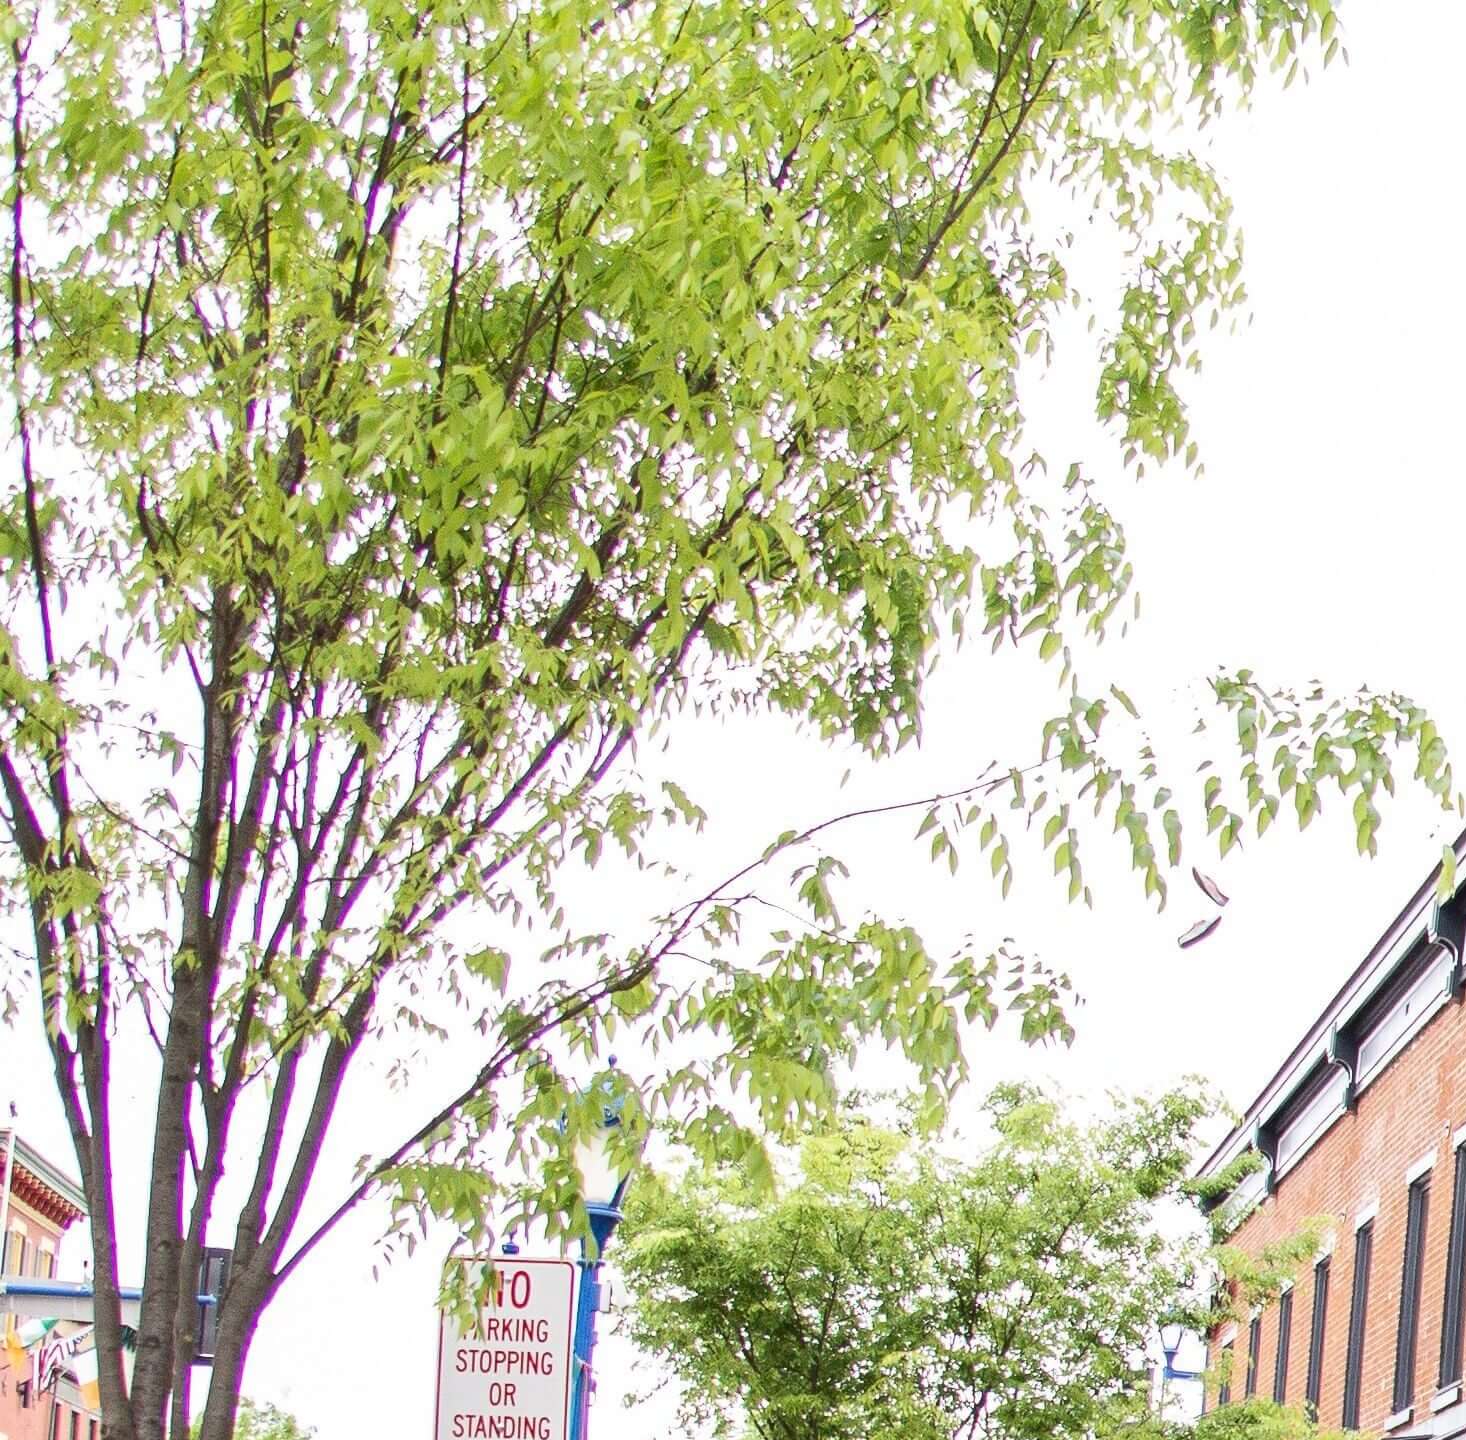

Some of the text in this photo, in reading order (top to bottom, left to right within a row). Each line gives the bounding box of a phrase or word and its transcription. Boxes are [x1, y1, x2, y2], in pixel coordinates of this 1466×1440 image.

[464, 1318, 549, 1343] RKING
[455, 1349, 553, 1375] STOPPING
[489, 1382, 516, 1407] OR
[452, 1414, 551, 1440] STANDING
